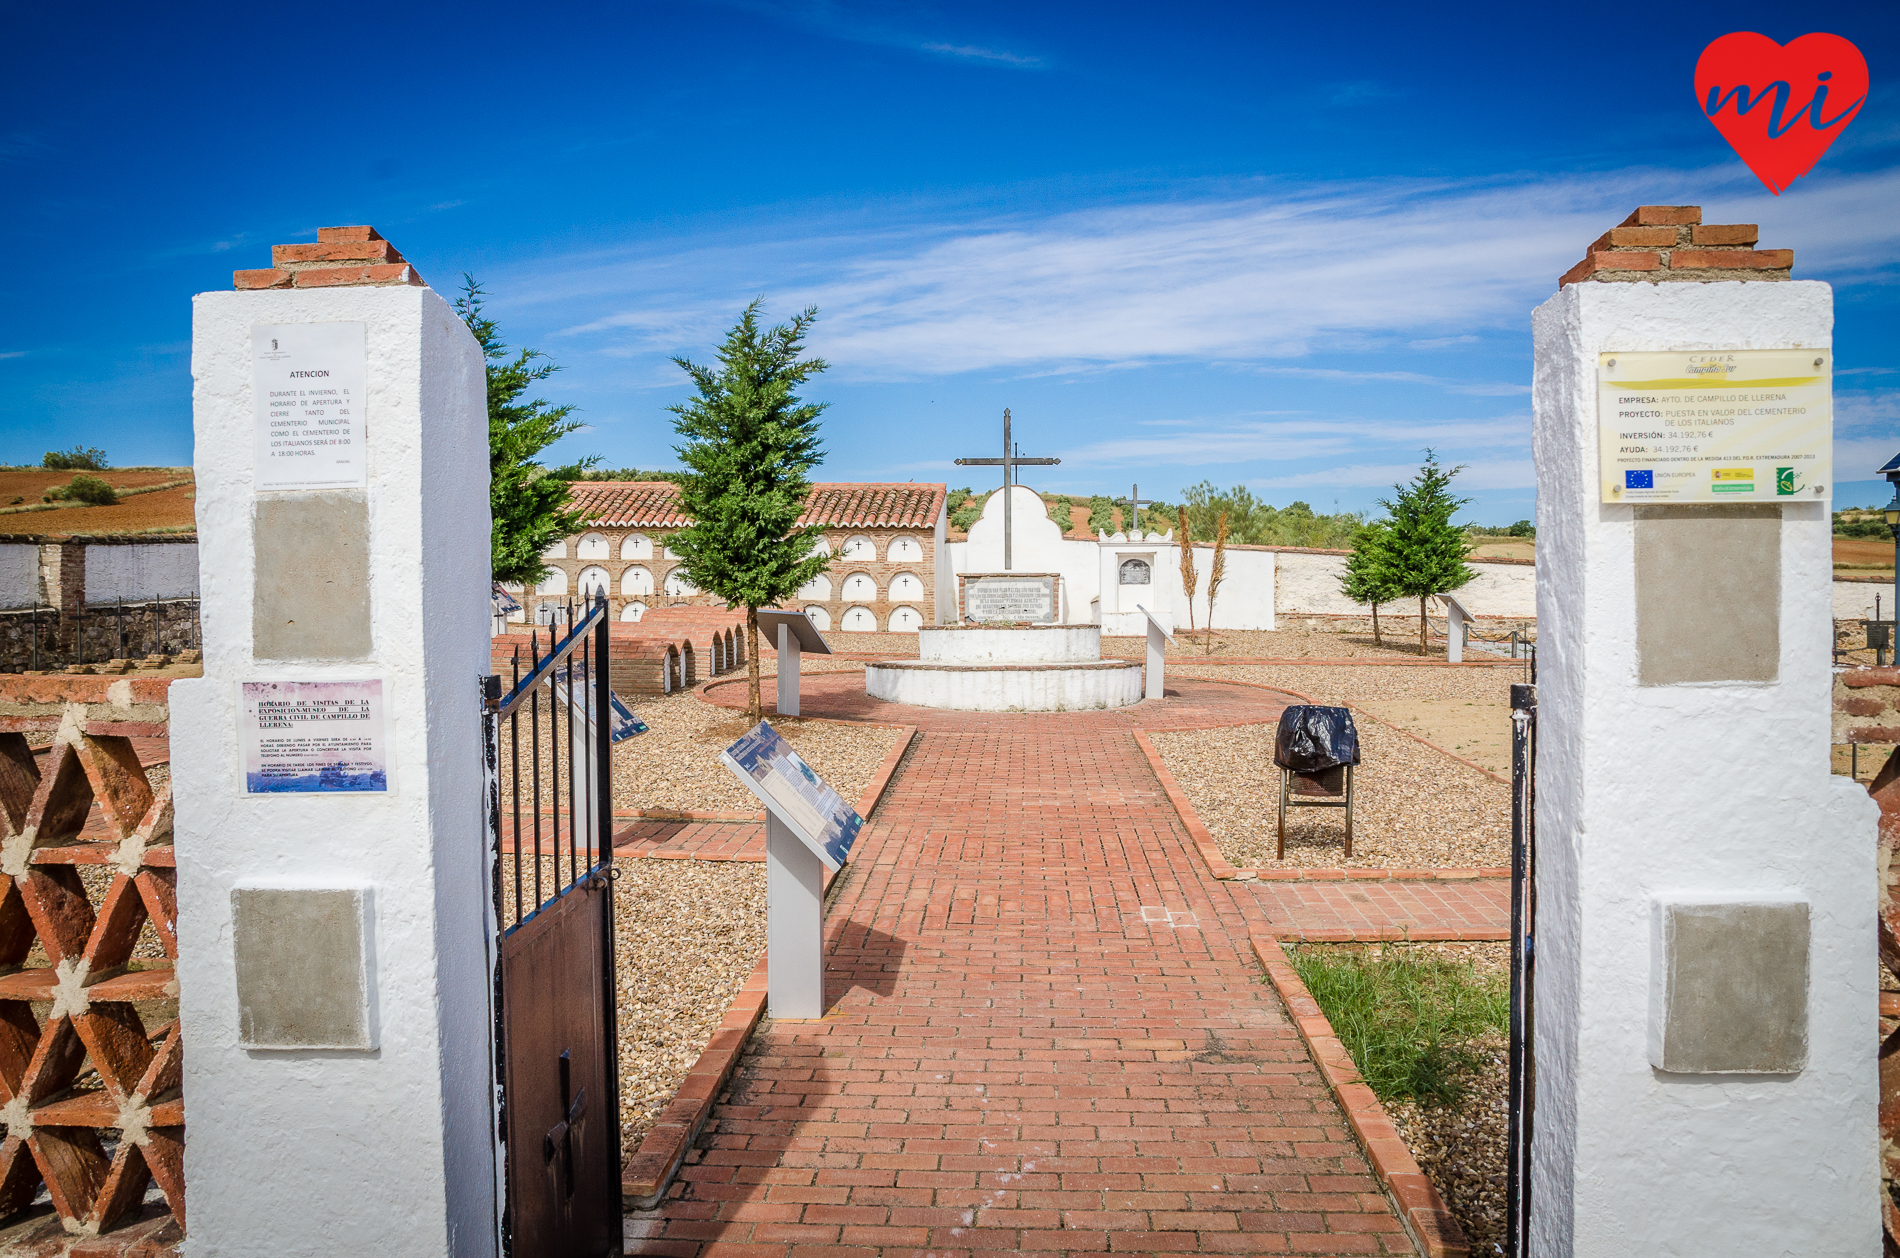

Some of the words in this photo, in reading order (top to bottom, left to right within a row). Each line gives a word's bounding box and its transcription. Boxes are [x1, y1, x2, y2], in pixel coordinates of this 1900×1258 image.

[1686, 364, 1721, 375] Campiña
[1722, 364, 1737, 372] Sur
[1620, 431, 1665, 439] INVERSIÓN:
